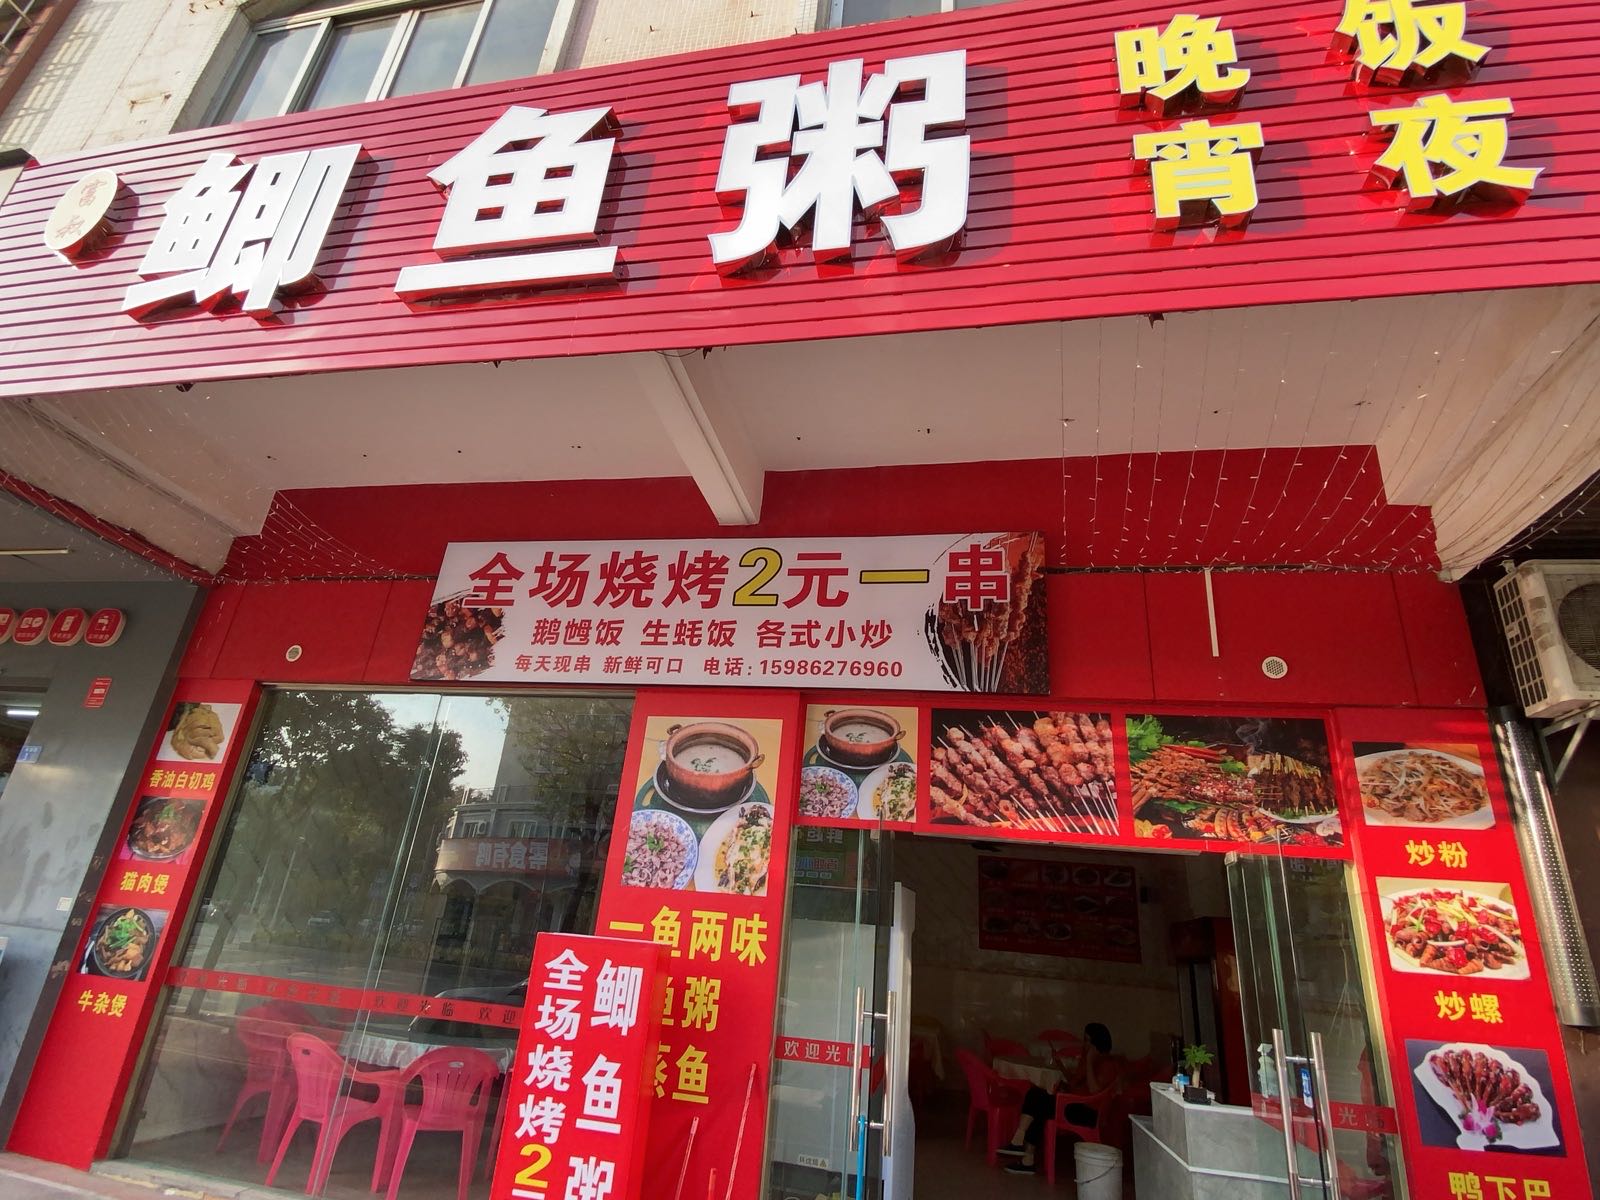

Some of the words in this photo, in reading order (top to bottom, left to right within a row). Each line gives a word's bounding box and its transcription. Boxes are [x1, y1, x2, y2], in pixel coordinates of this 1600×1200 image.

[121, 49, 970, 311] 鲫鱼粥
[462, 542, 1011, 612] 全场烧烤2元一串
[640, 618, 738, 649] 生蚝饭
[756, 618, 895, 650] 各式小炒
[514, 654, 592, 675] 每天现串
[602, 655, 684, 675] 新鲜可口
[149, 769, 216, 791] 香油白切鸡
[1405, 839, 1469, 869] 炒粉
[609, 905, 768, 967] 一鱼两味
[77, 990, 128, 1018] 牛杂煲
[1433, 990, 1505, 1025] 炒螺
[511, 948, 590, 1200] 全场烧烤2
[563, 958, 644, 1200] 鲫鱼粥
[1448, 1171, 1552, 1200] 鸭下巴
